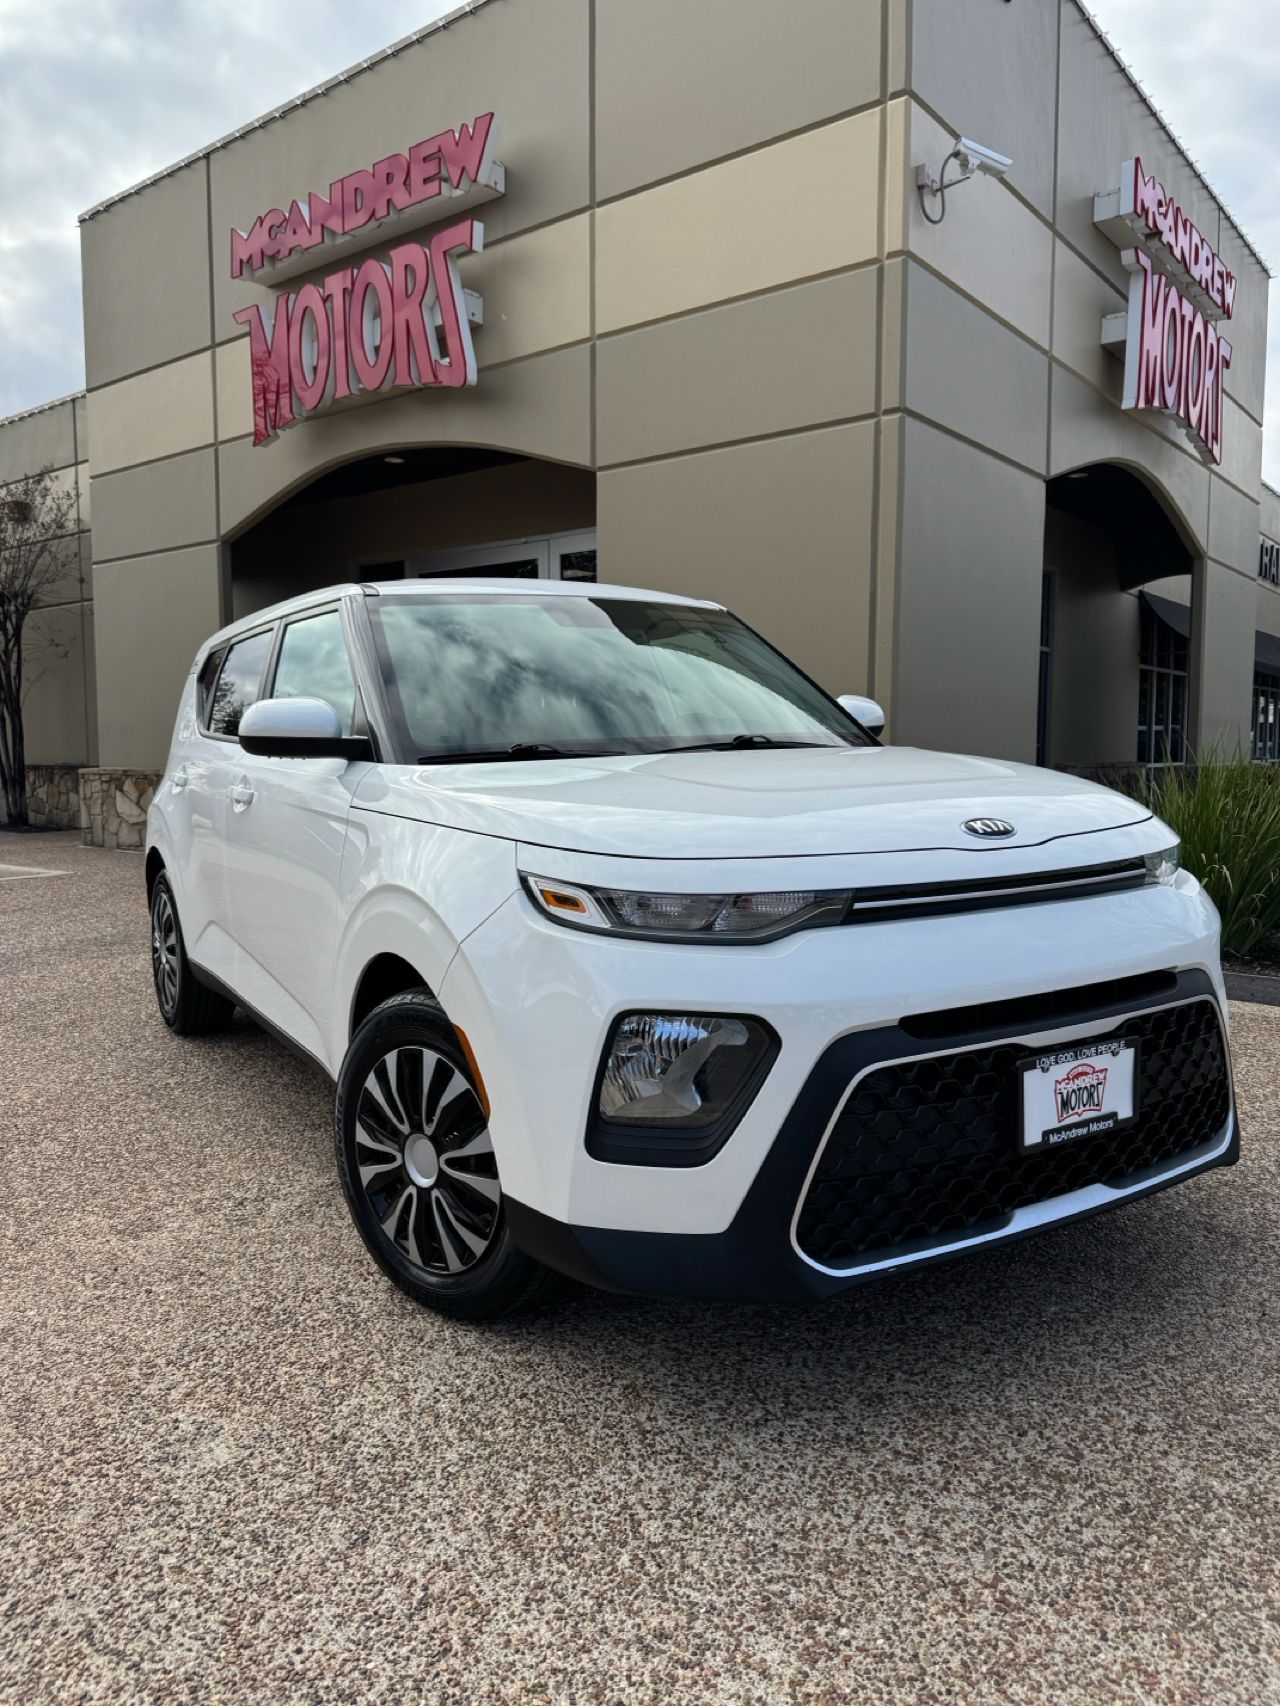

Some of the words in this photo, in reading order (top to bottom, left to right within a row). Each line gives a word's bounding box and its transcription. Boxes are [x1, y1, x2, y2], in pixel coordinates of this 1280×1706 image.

[232, 219, 475, 447] MOTORS
[1134, 246, 1233, 465] MOTORS
[966, 819, 1014, 834] KIA
[1036, 1056, 1056, 1069] LOVE
[1077, 1047, 1097, 1060] LOVE
[1057, 1081, 1103, 1118] MOTORS
[1049, 1126, 1089, 1144] McAndrew
[1089, 1119, 1114, 1134] Motors
